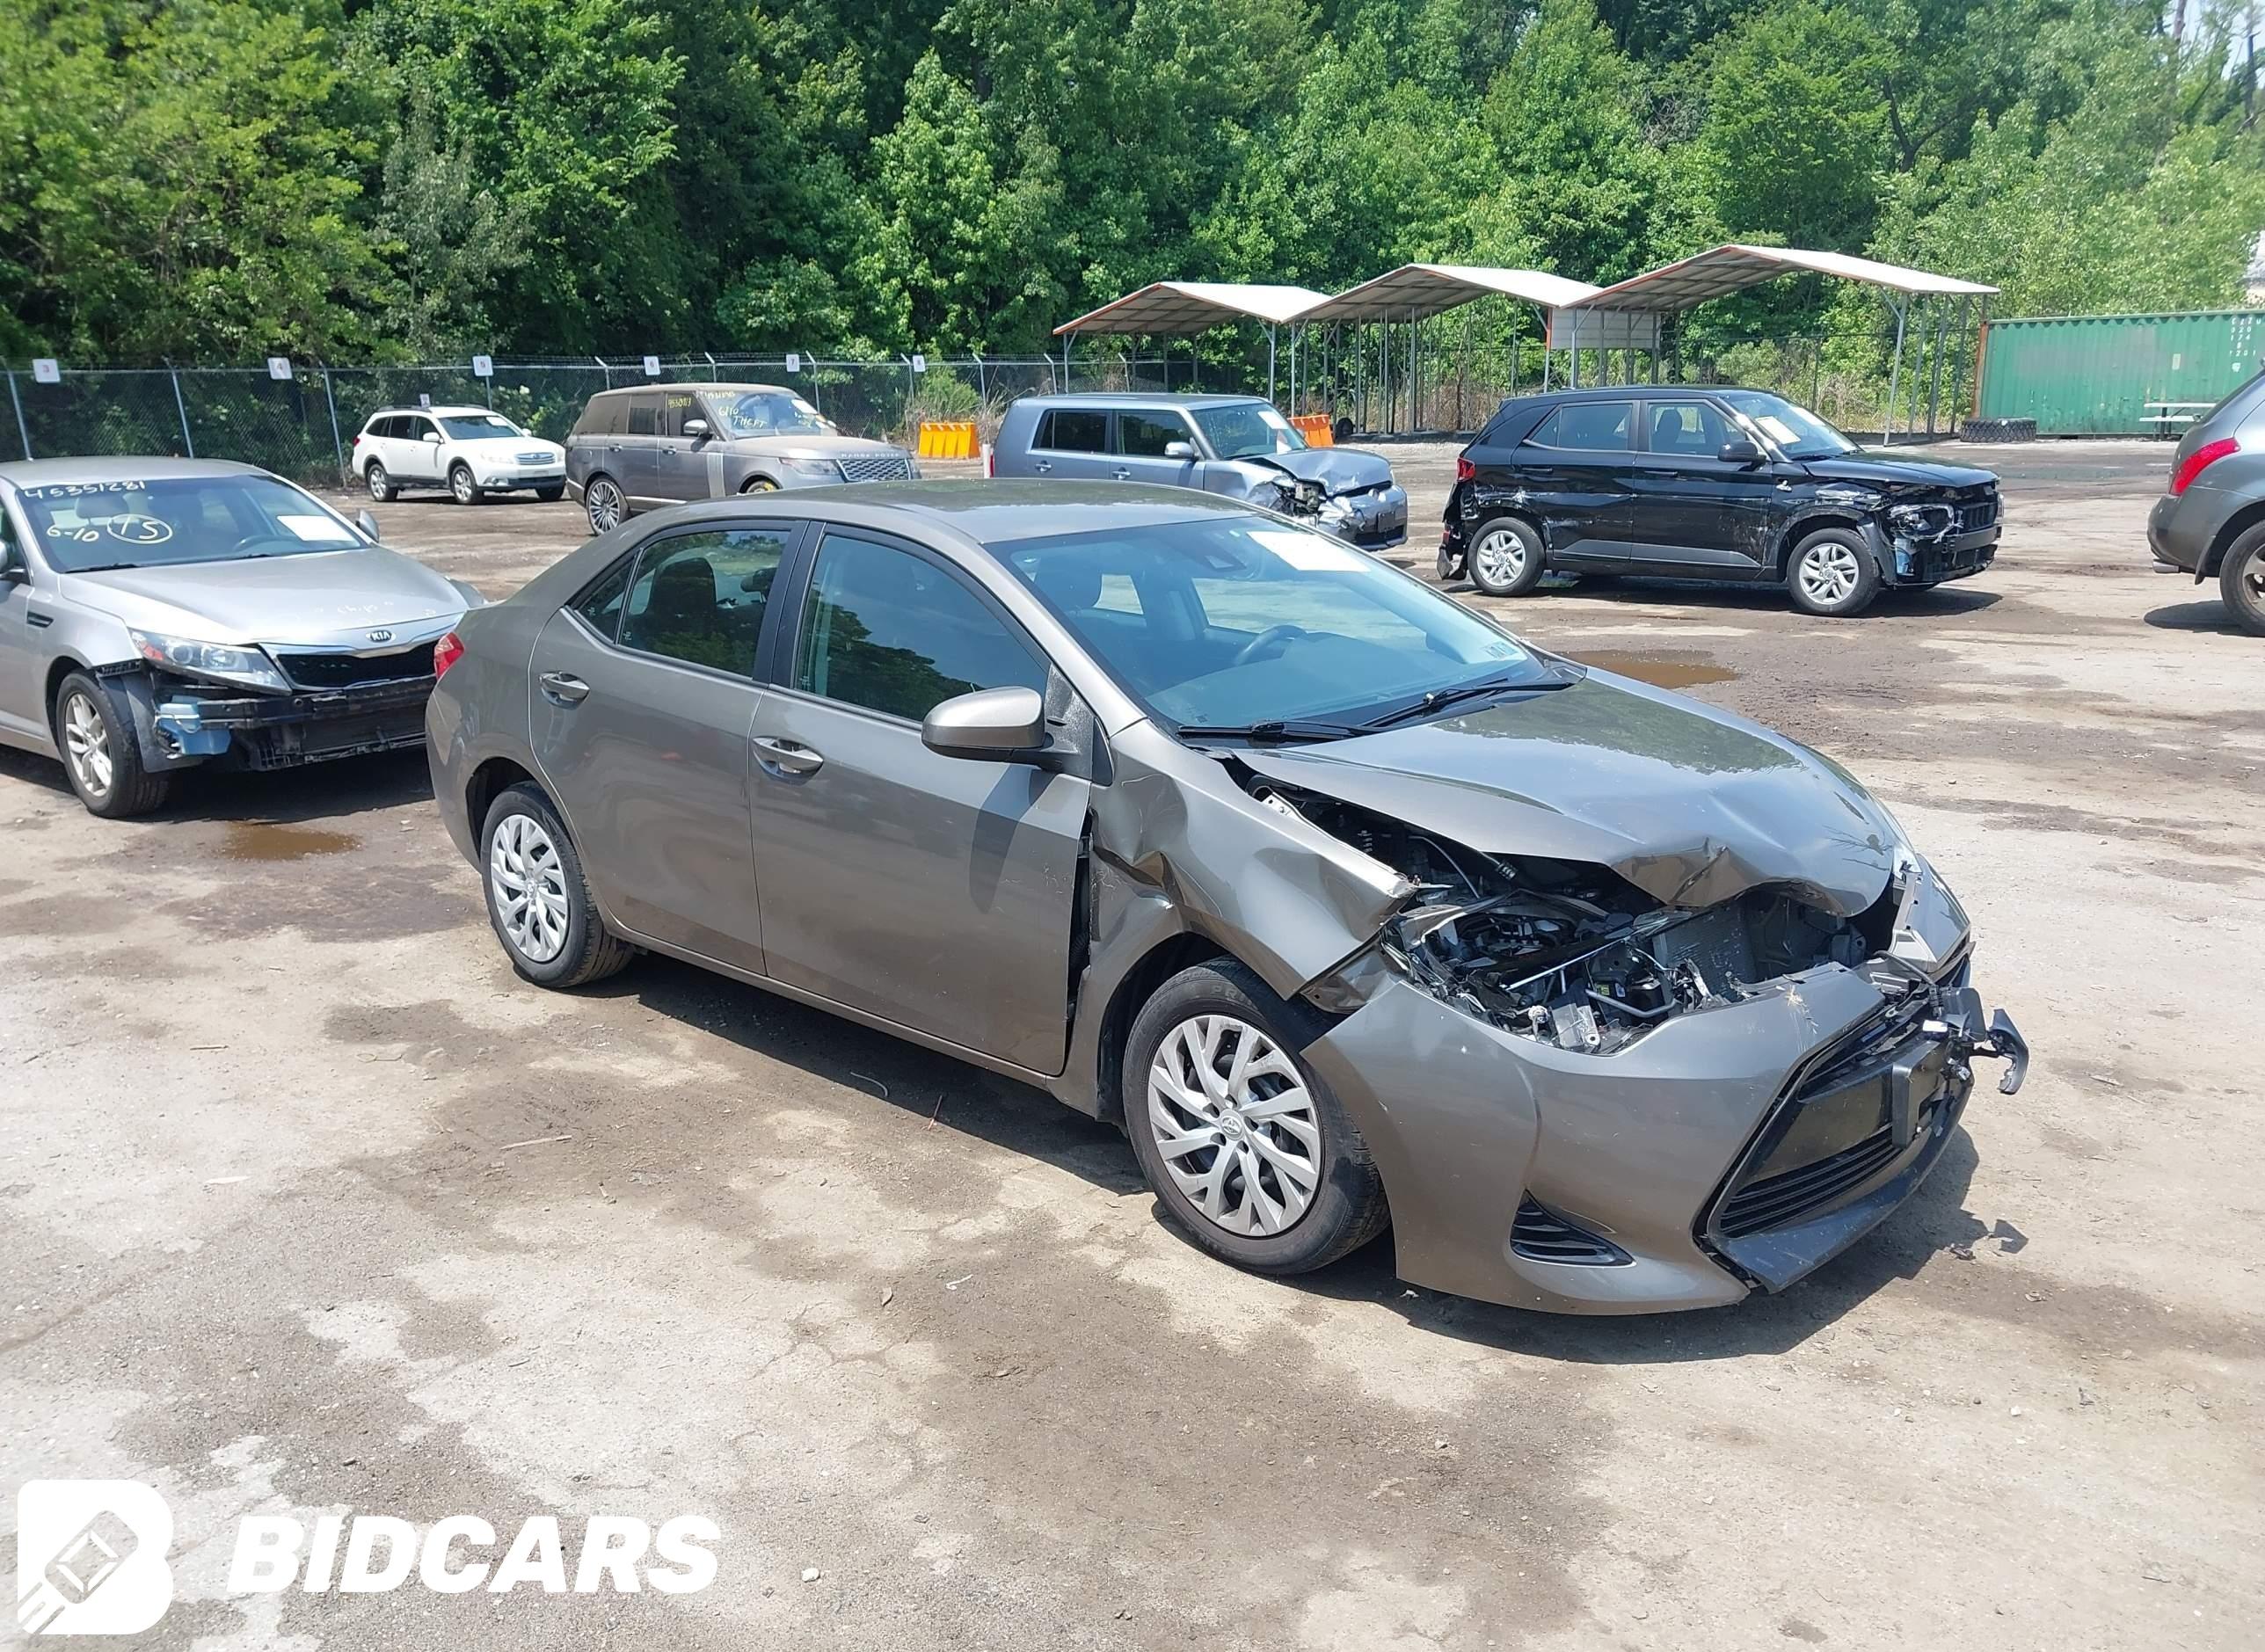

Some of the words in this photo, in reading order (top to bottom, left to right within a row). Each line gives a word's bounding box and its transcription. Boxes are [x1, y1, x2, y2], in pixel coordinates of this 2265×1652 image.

[25, 480, 146, 499] 45351281
[47, 525, 99, 542] 6-10
[371, 631, 391, 641] KIA
